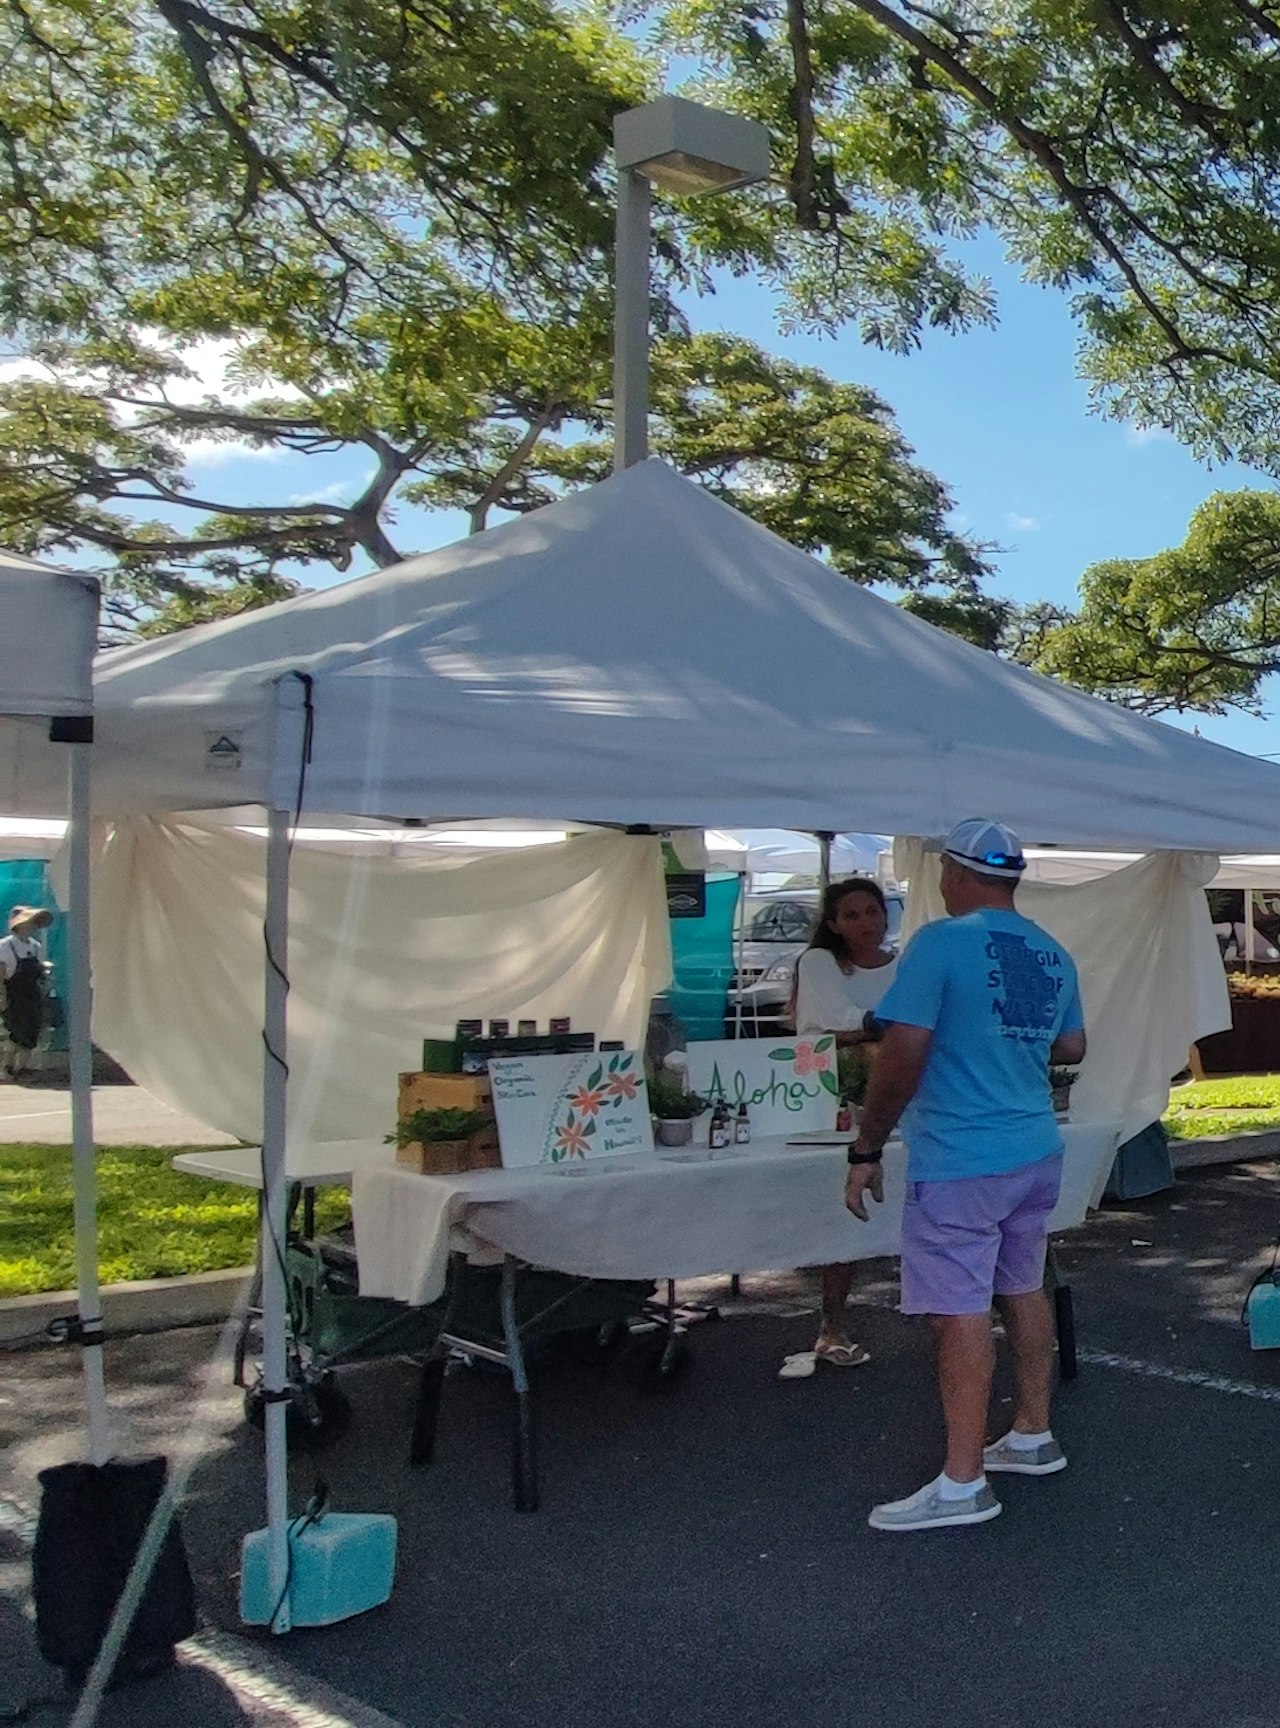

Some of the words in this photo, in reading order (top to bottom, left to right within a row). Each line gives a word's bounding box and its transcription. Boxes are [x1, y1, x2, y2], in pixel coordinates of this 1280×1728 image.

[985, 942, 1062, 968] GEORGIA
[987, 970, 1038, 992] STATE
[1042, 975, 1064, 994] OF
[702, 1060, 821, 1113] Aloha
